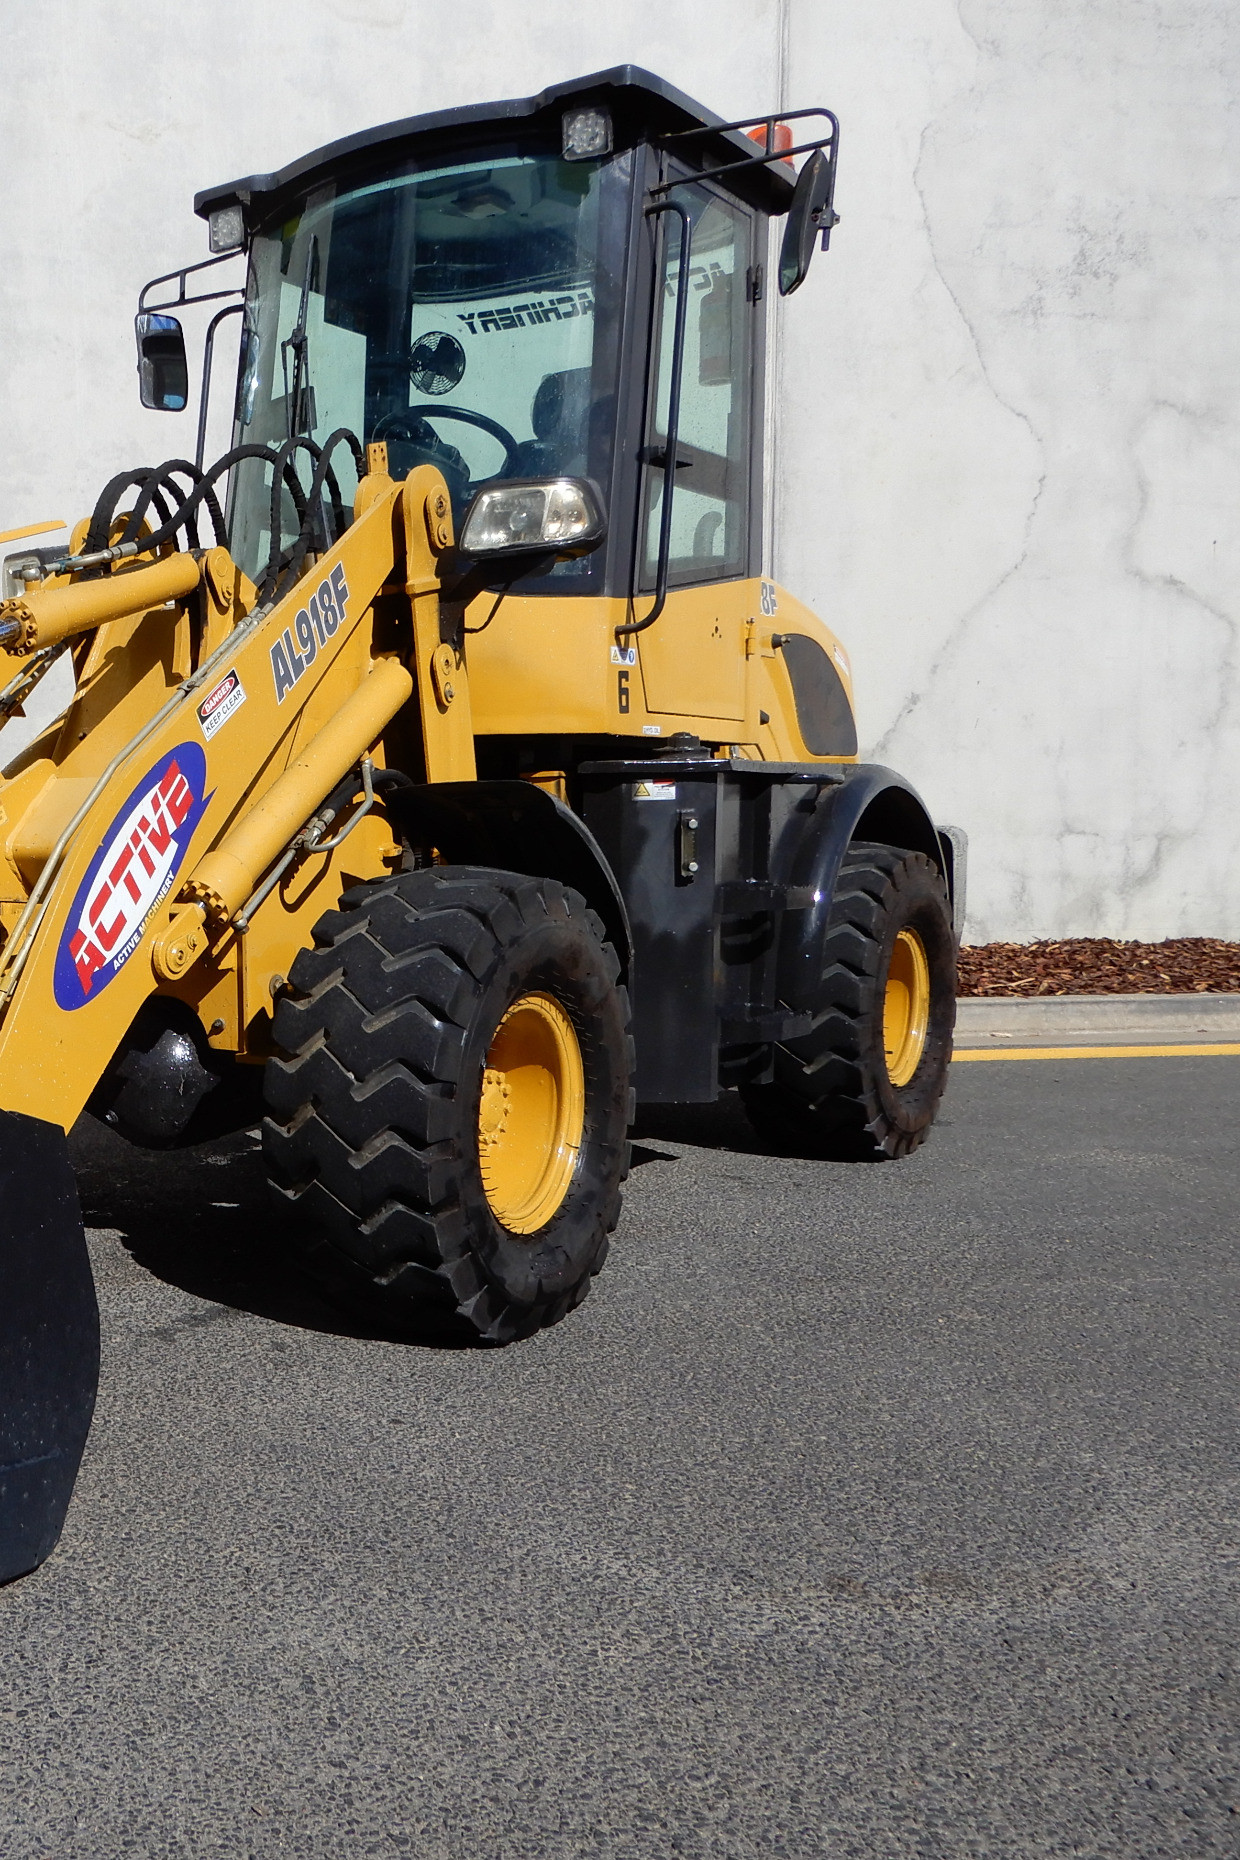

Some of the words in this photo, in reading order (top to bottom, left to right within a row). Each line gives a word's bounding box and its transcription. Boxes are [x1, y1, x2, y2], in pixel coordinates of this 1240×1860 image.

[761, 581, 777, 616] 8F
[270, 561, 349, 705] AL918F
[204, 681, 231, 713] DANGER
[205, 711, 221, 733] KEEP
[221, 689, 242, 715] CLEAR
[618, 671, 629, 714] 6
[113, 933, 141, 970] ACTIVE
[139, 870, 175, 935] MACHINERY
